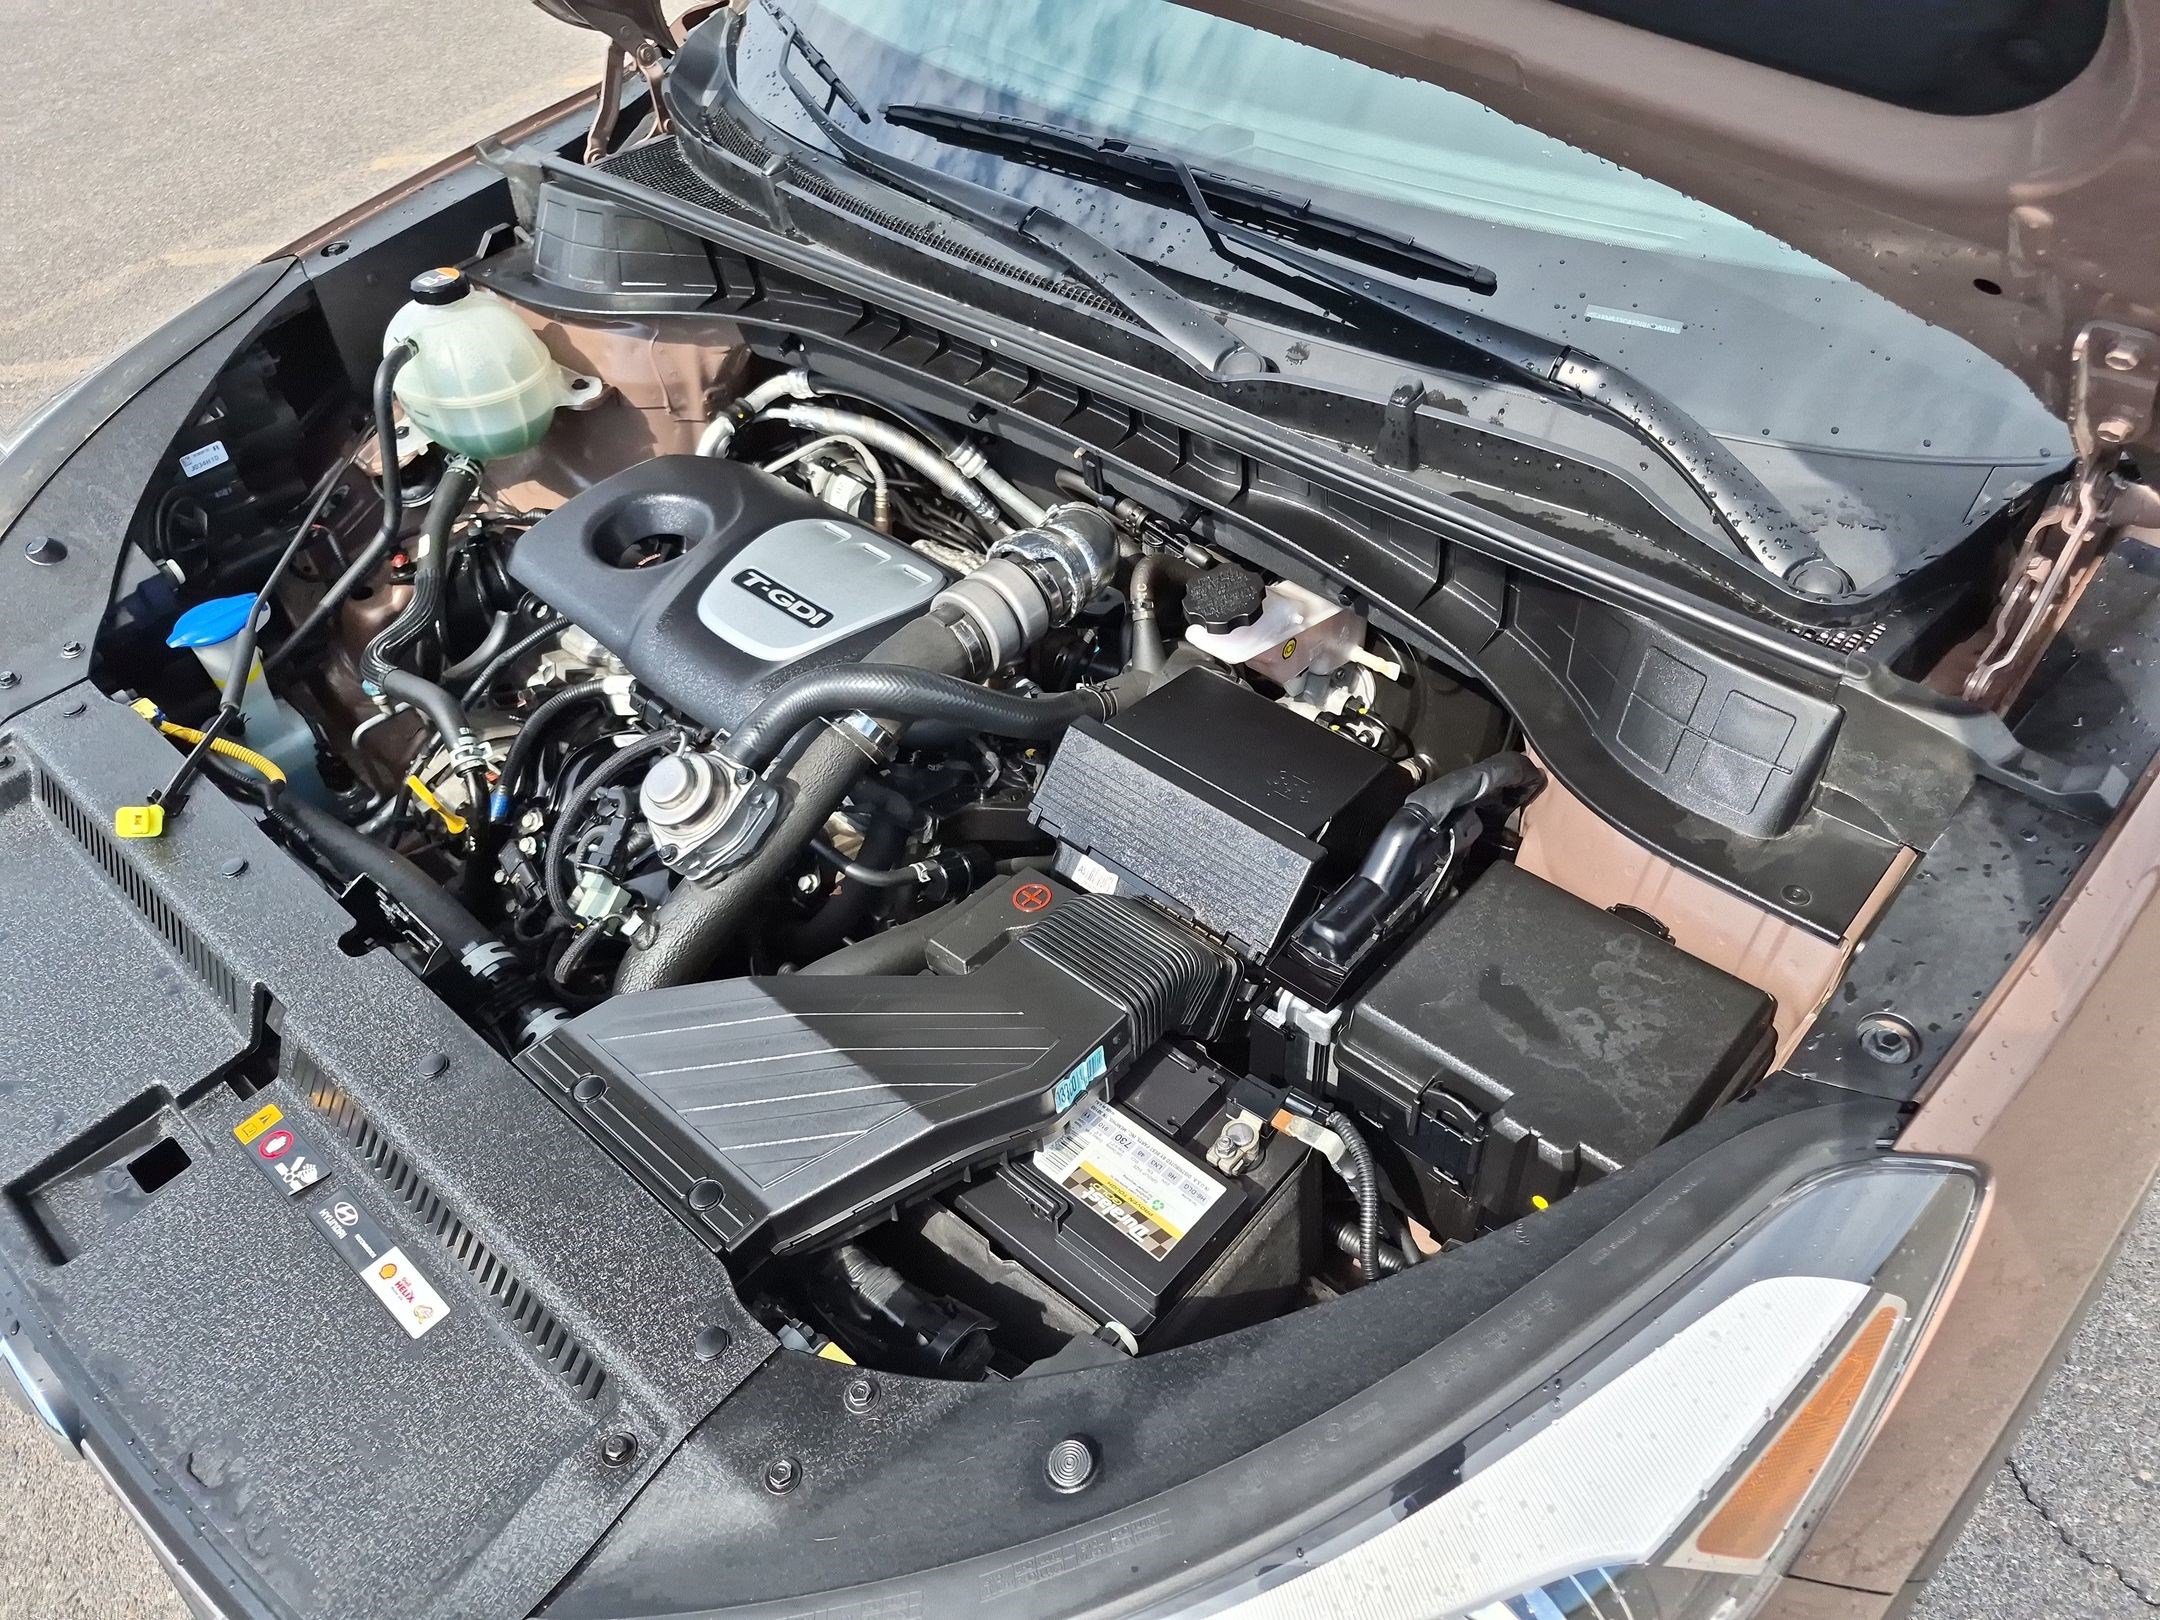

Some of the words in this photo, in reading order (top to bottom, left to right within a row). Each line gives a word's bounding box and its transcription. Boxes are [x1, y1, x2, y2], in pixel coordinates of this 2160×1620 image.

[743, 572, 827, 624] T-GDI
[1097, 1121, 1109, 1131] 910
[1113, 1132, 1133, 1148] 730
[1149, 1159, 1163, 1170] LN3
[1091, 1181, 1123, 1205] GOLD
[318, 1208, 347, 1240] HYUNDAI
[1081, 1185, 1149, 1242] Duralast
[394, 1280, 415, 1303] HELIX
